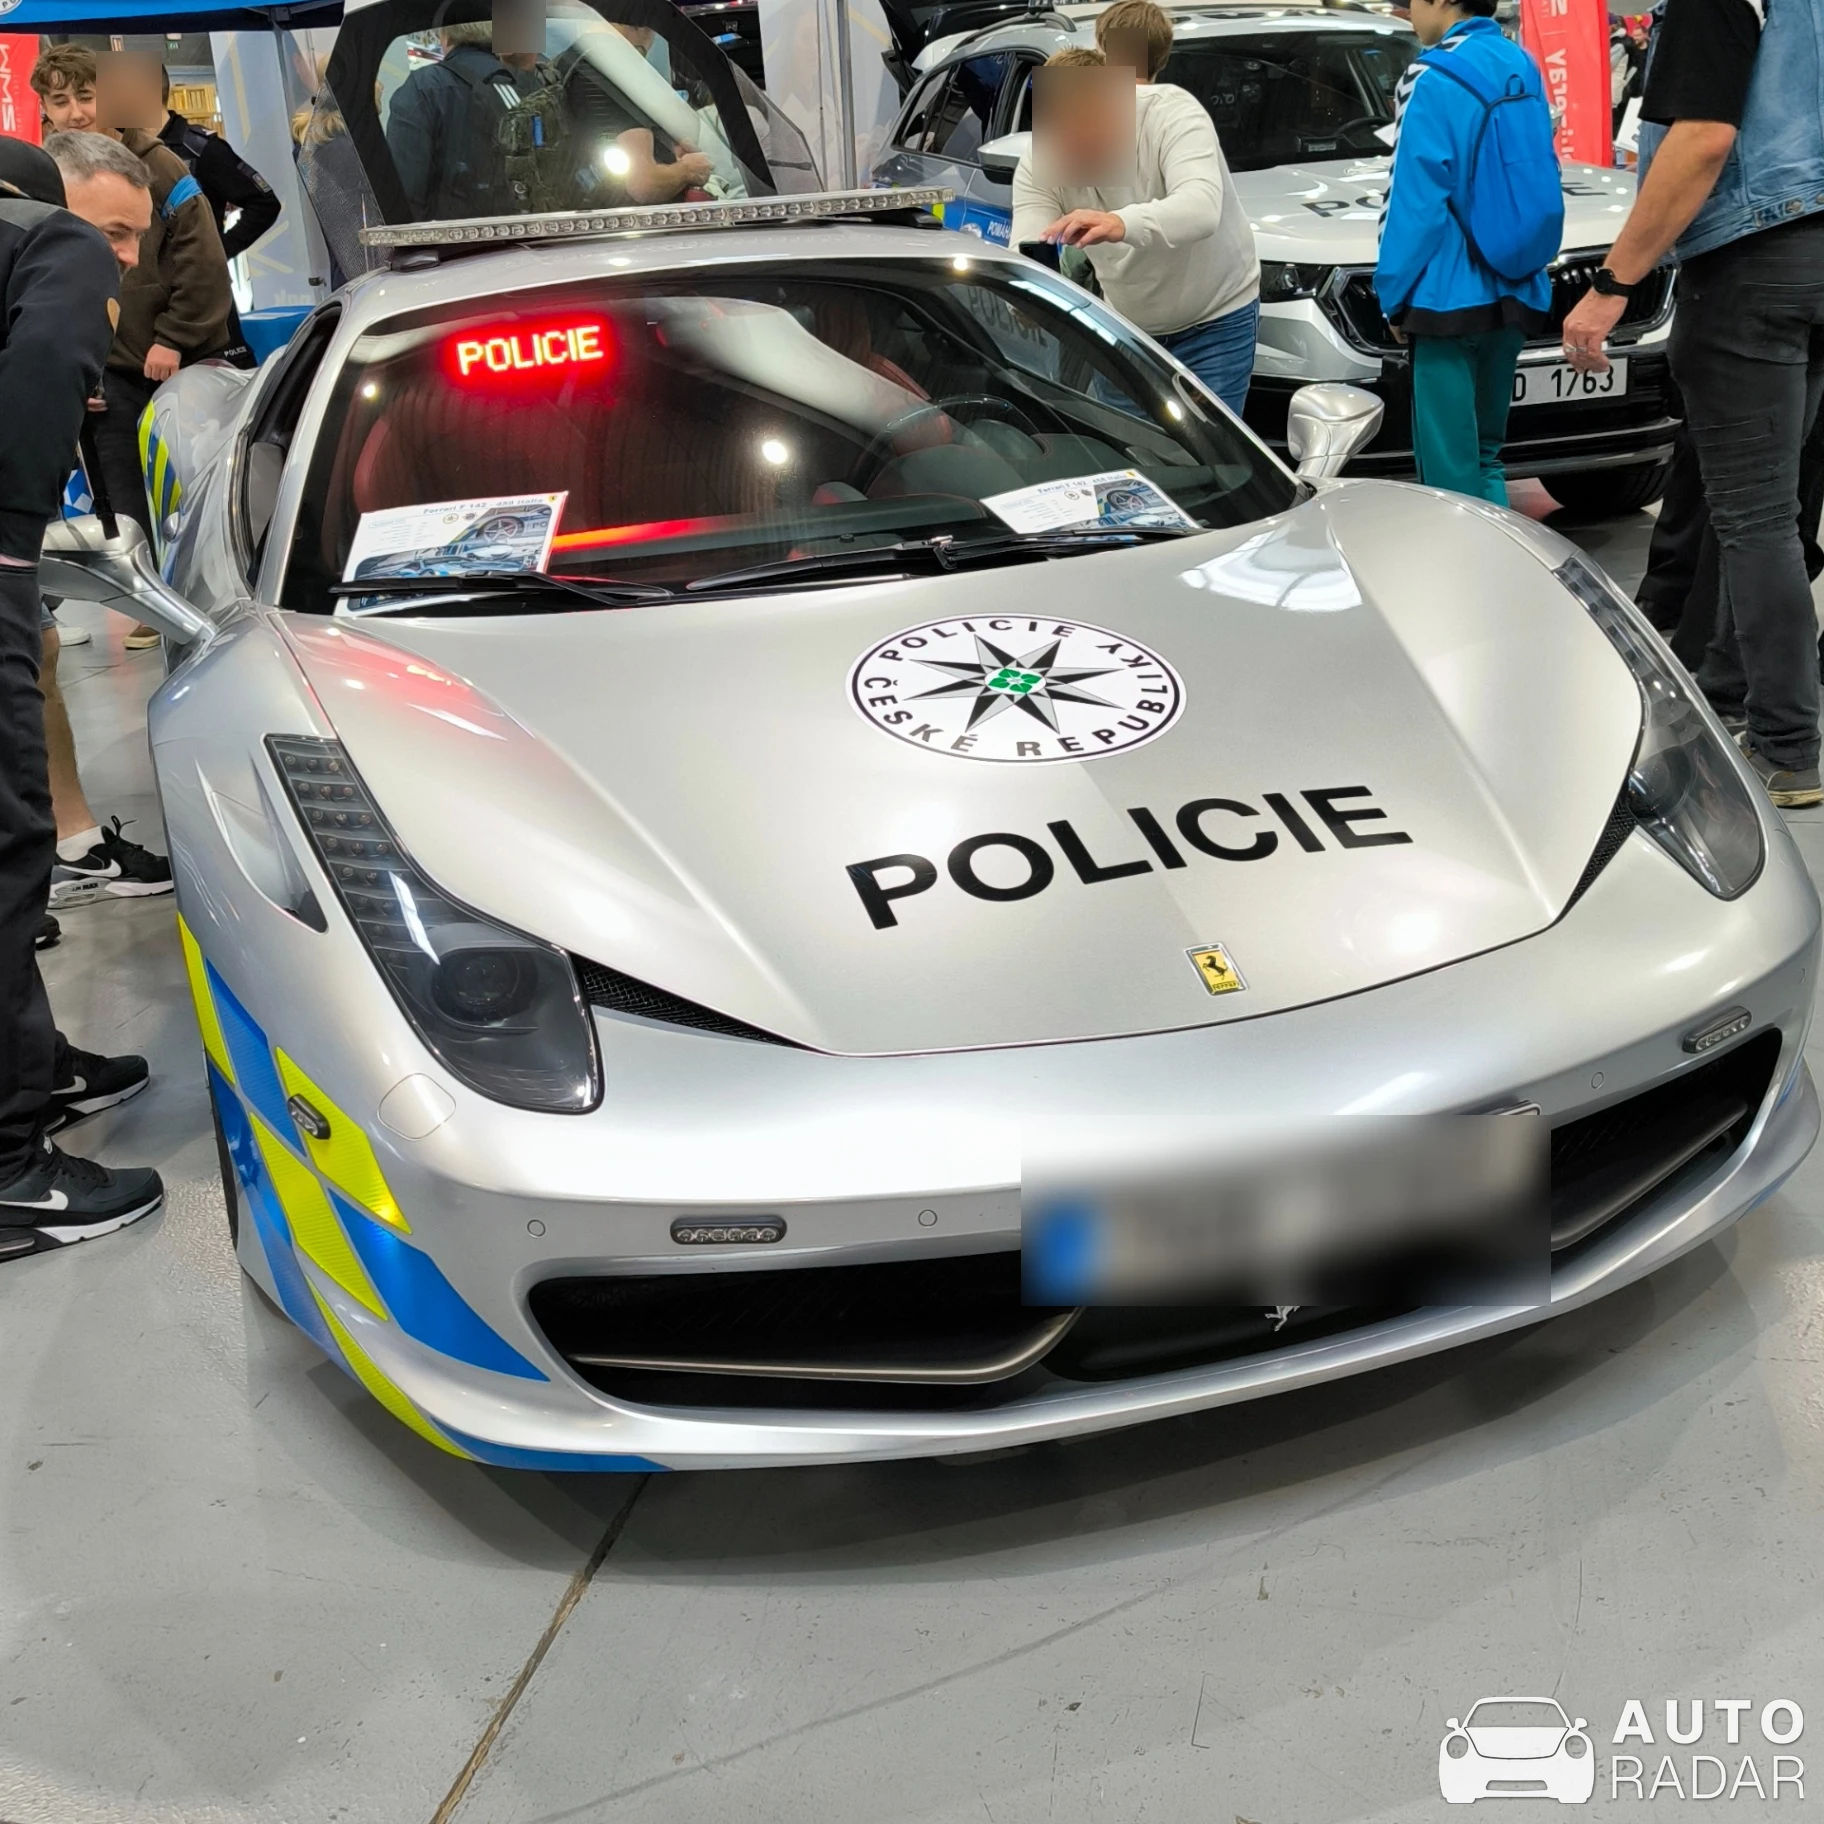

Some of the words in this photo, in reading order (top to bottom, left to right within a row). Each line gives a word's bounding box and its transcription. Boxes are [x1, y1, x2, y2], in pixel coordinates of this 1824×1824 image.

[457, 325, 603, 376] POLICIE
[1551, 365, 1614, 398] 1763
[423, 505, 456, 514] Ferrari
[878, 619, 1077, 663] POLICIE
[863, 676, 979, 753] ČESKÉ
[1015, 642, 1169, 757] REPUBLIKY
[845, 786, 1413, 930] POLICIE
